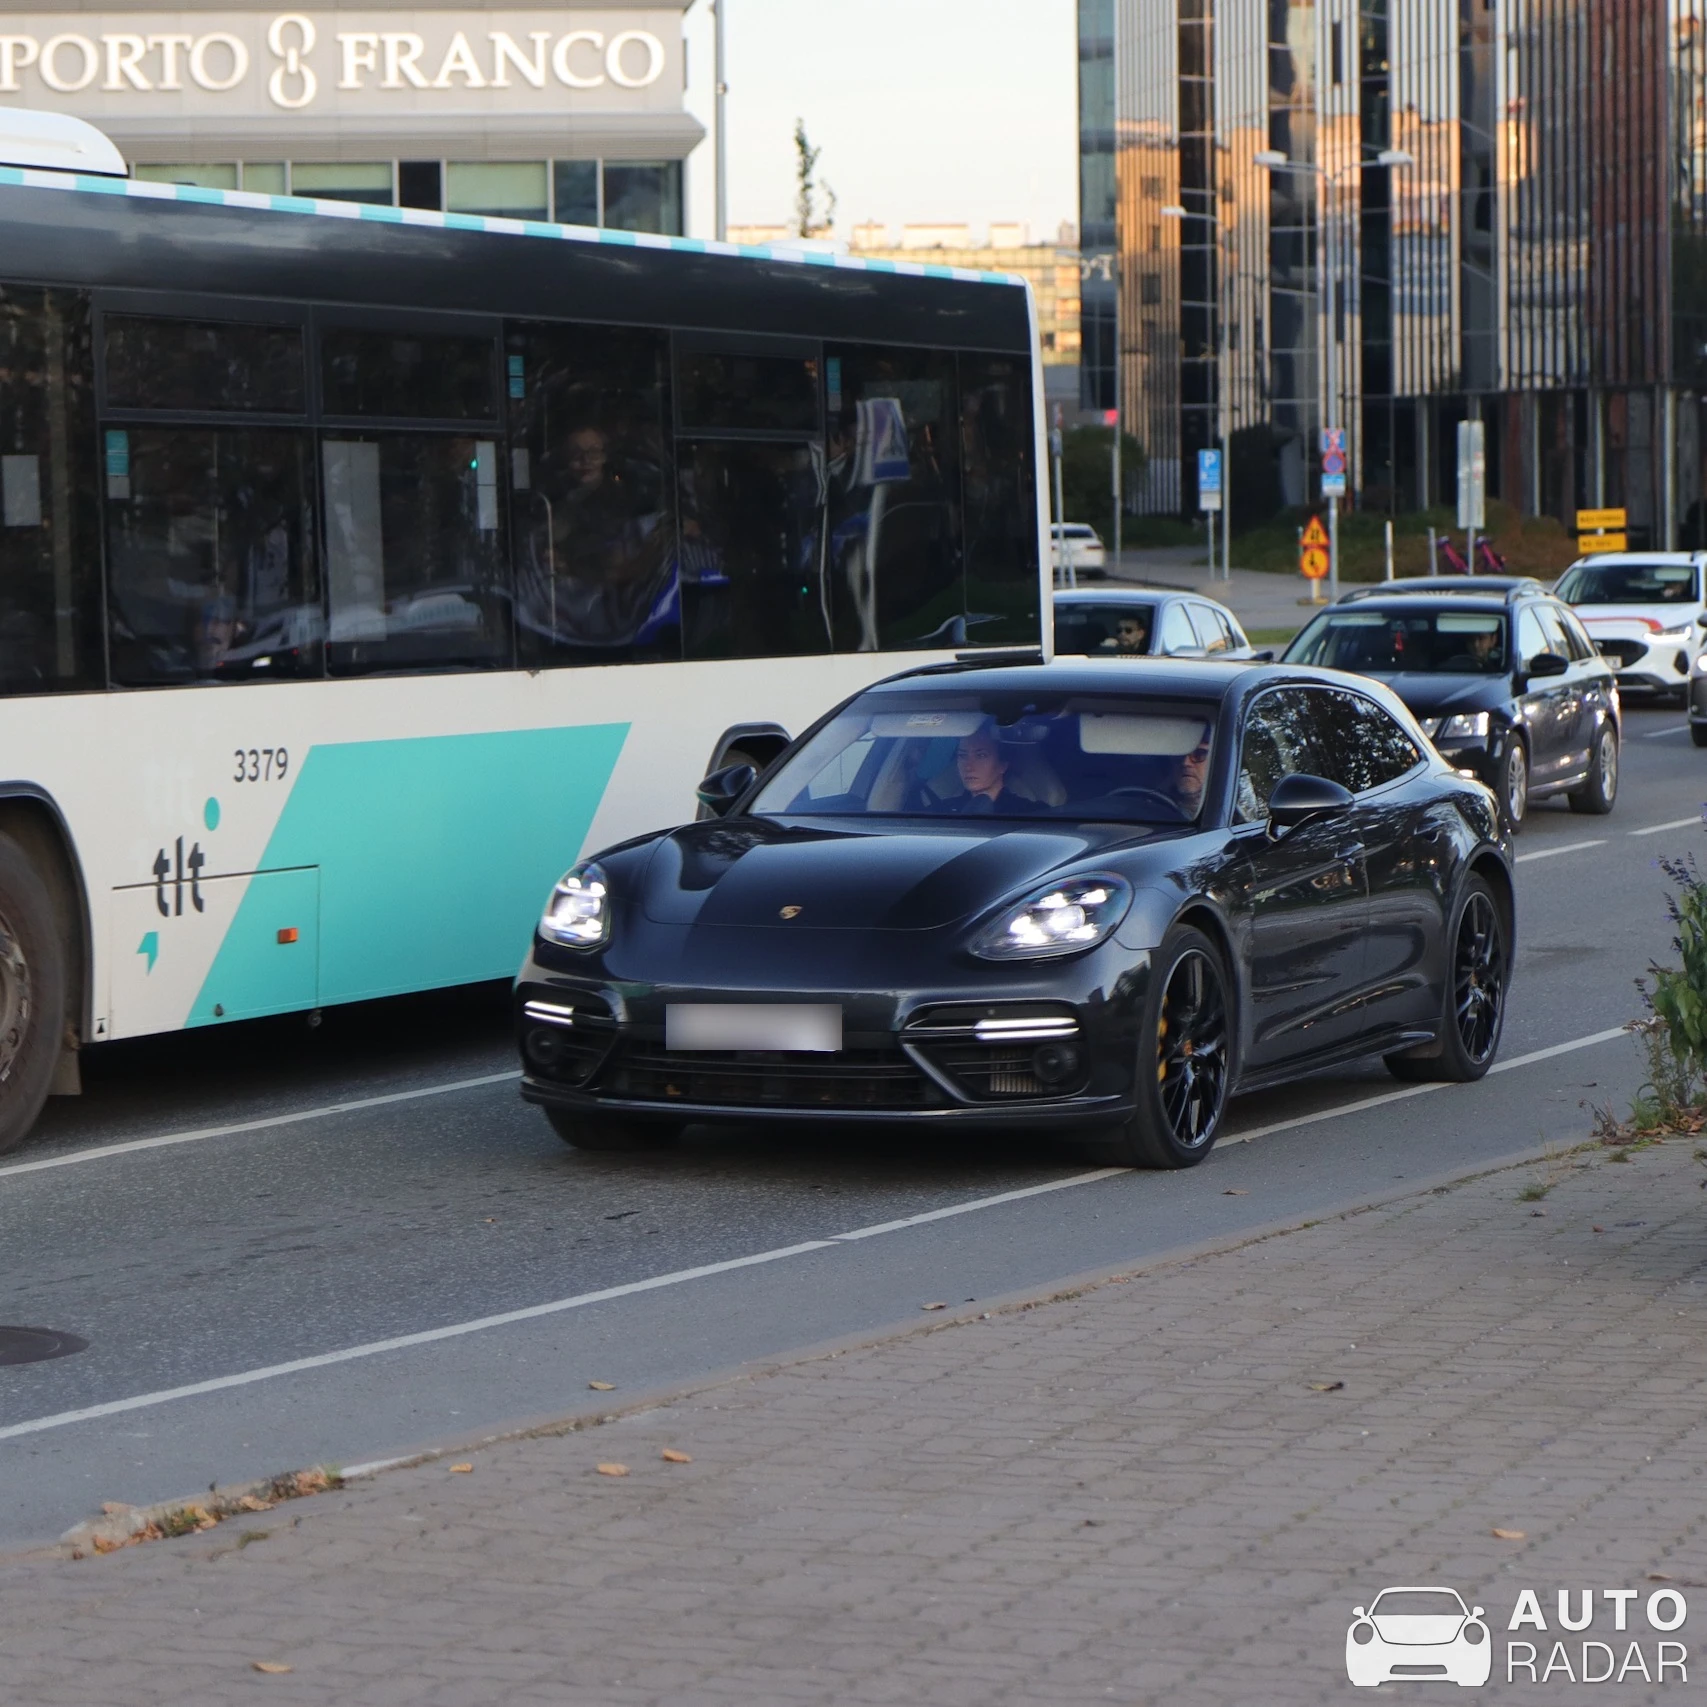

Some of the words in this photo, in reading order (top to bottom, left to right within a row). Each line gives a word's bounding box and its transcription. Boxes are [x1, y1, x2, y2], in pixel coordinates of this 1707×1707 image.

[0, 33, 249, 91] PORTO
[336, 29, 666, 90] FRANCO
[233, 747, 289, 783] 3379
[152, 834, 205, 918] tlt
